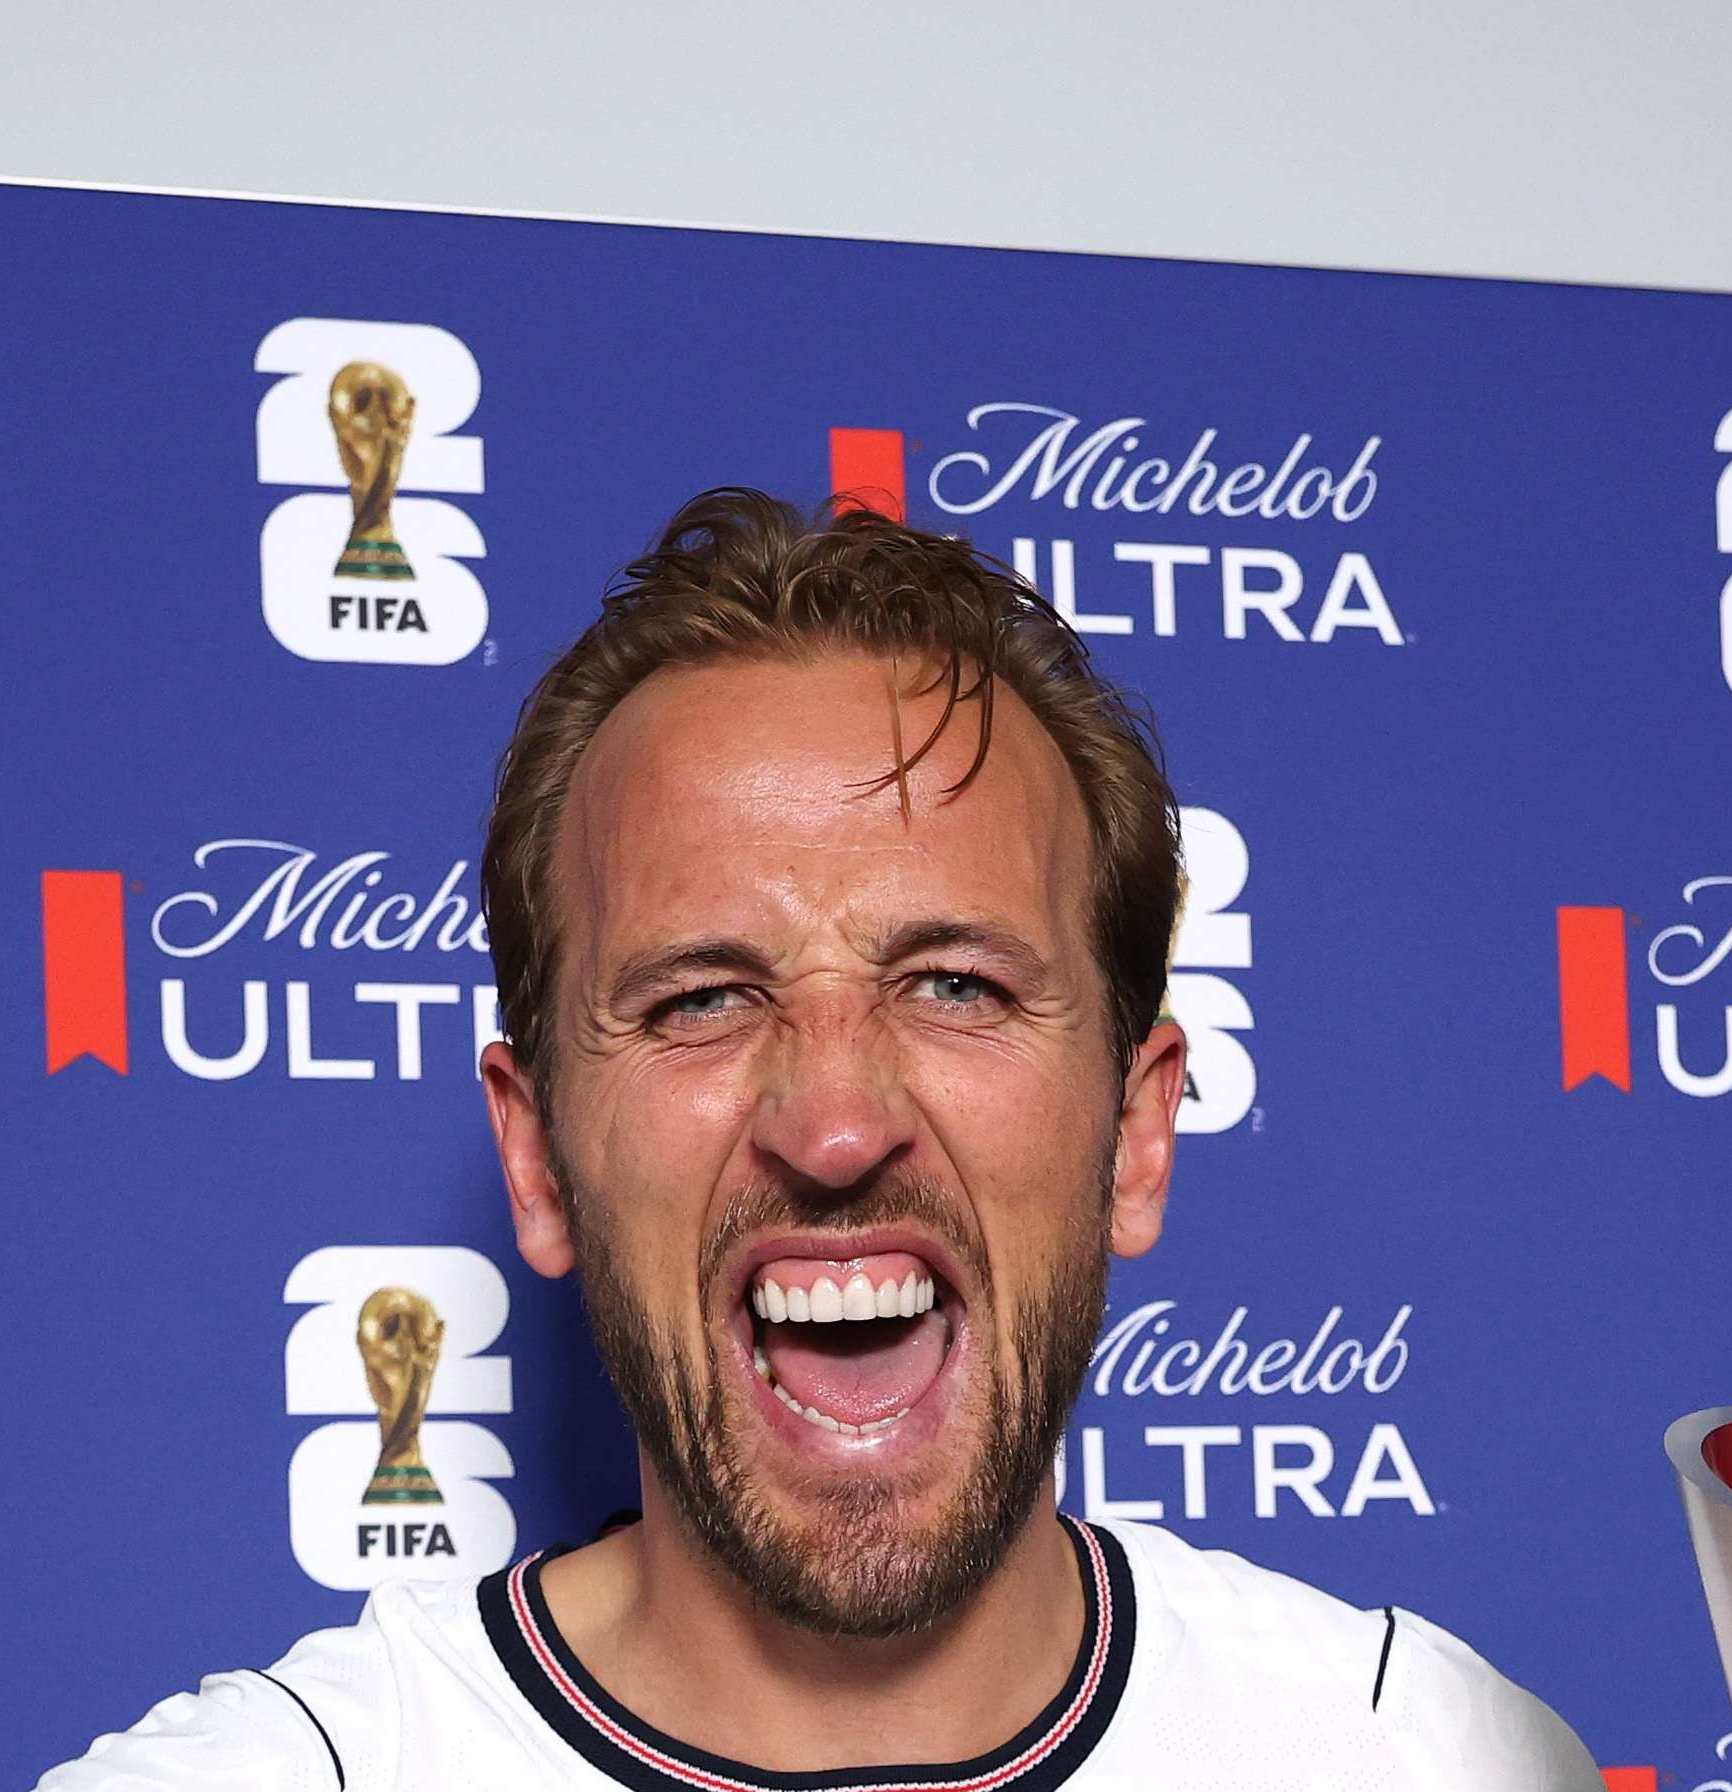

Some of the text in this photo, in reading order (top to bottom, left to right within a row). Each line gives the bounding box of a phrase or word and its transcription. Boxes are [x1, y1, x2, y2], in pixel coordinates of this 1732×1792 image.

[929, 403, 1381, 522] Michelob
[331, 596, 427, 632] FIFA
[152, 839, 490, 957] Mich
[161, 979, 497, 1081] ULT
[1055, 1422, 1435, 1520] LTRA
[359, 1524, 456, 1557] FIFA
